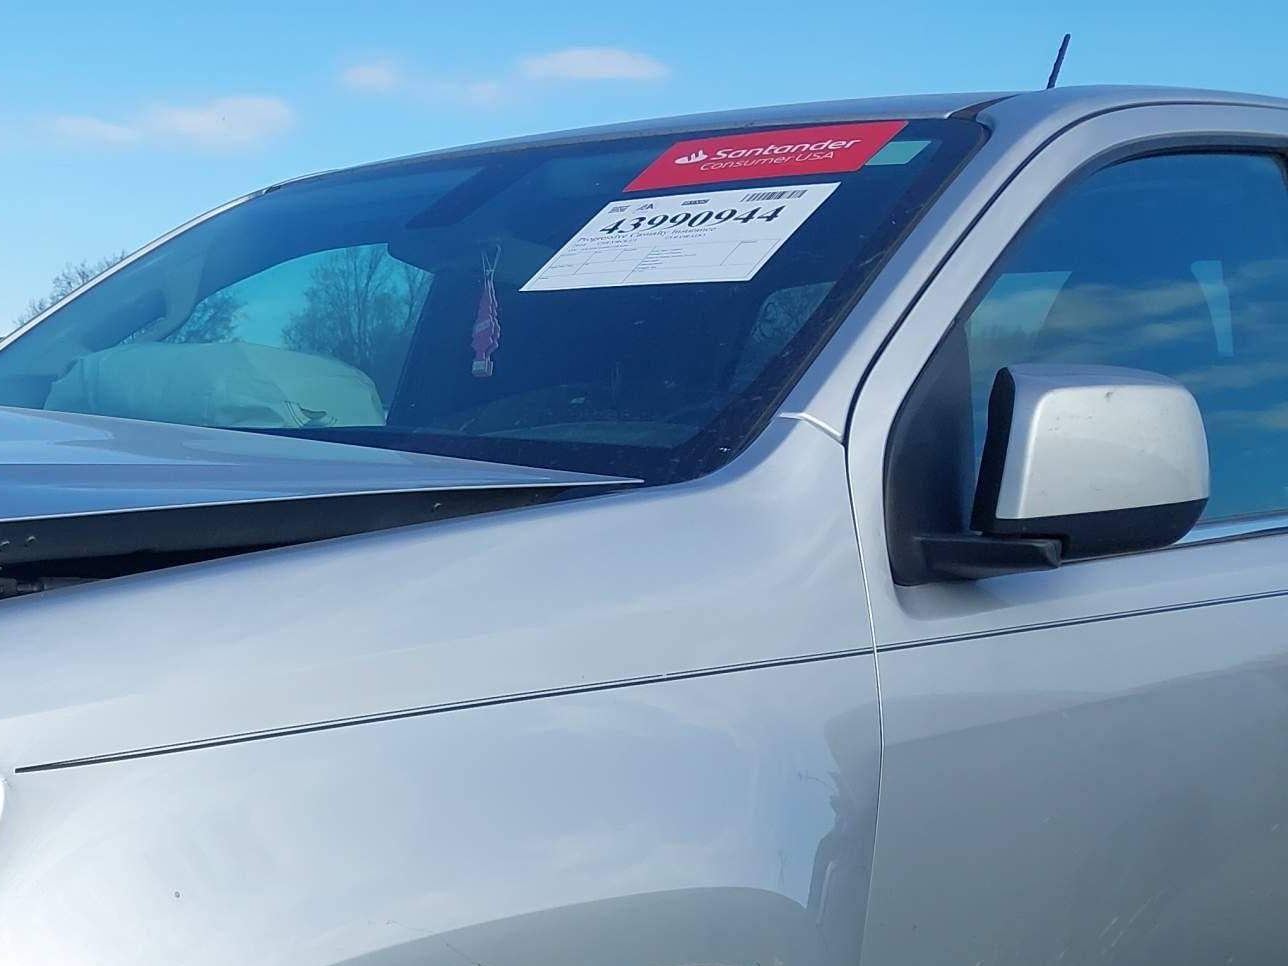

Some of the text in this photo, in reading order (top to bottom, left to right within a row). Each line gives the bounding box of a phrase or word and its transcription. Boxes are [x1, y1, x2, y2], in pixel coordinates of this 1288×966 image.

[710, 139, 862, 160] Santander
[699, 150, 835, 172] Consumer USA
[599, 205, 787, 235] 43990944
